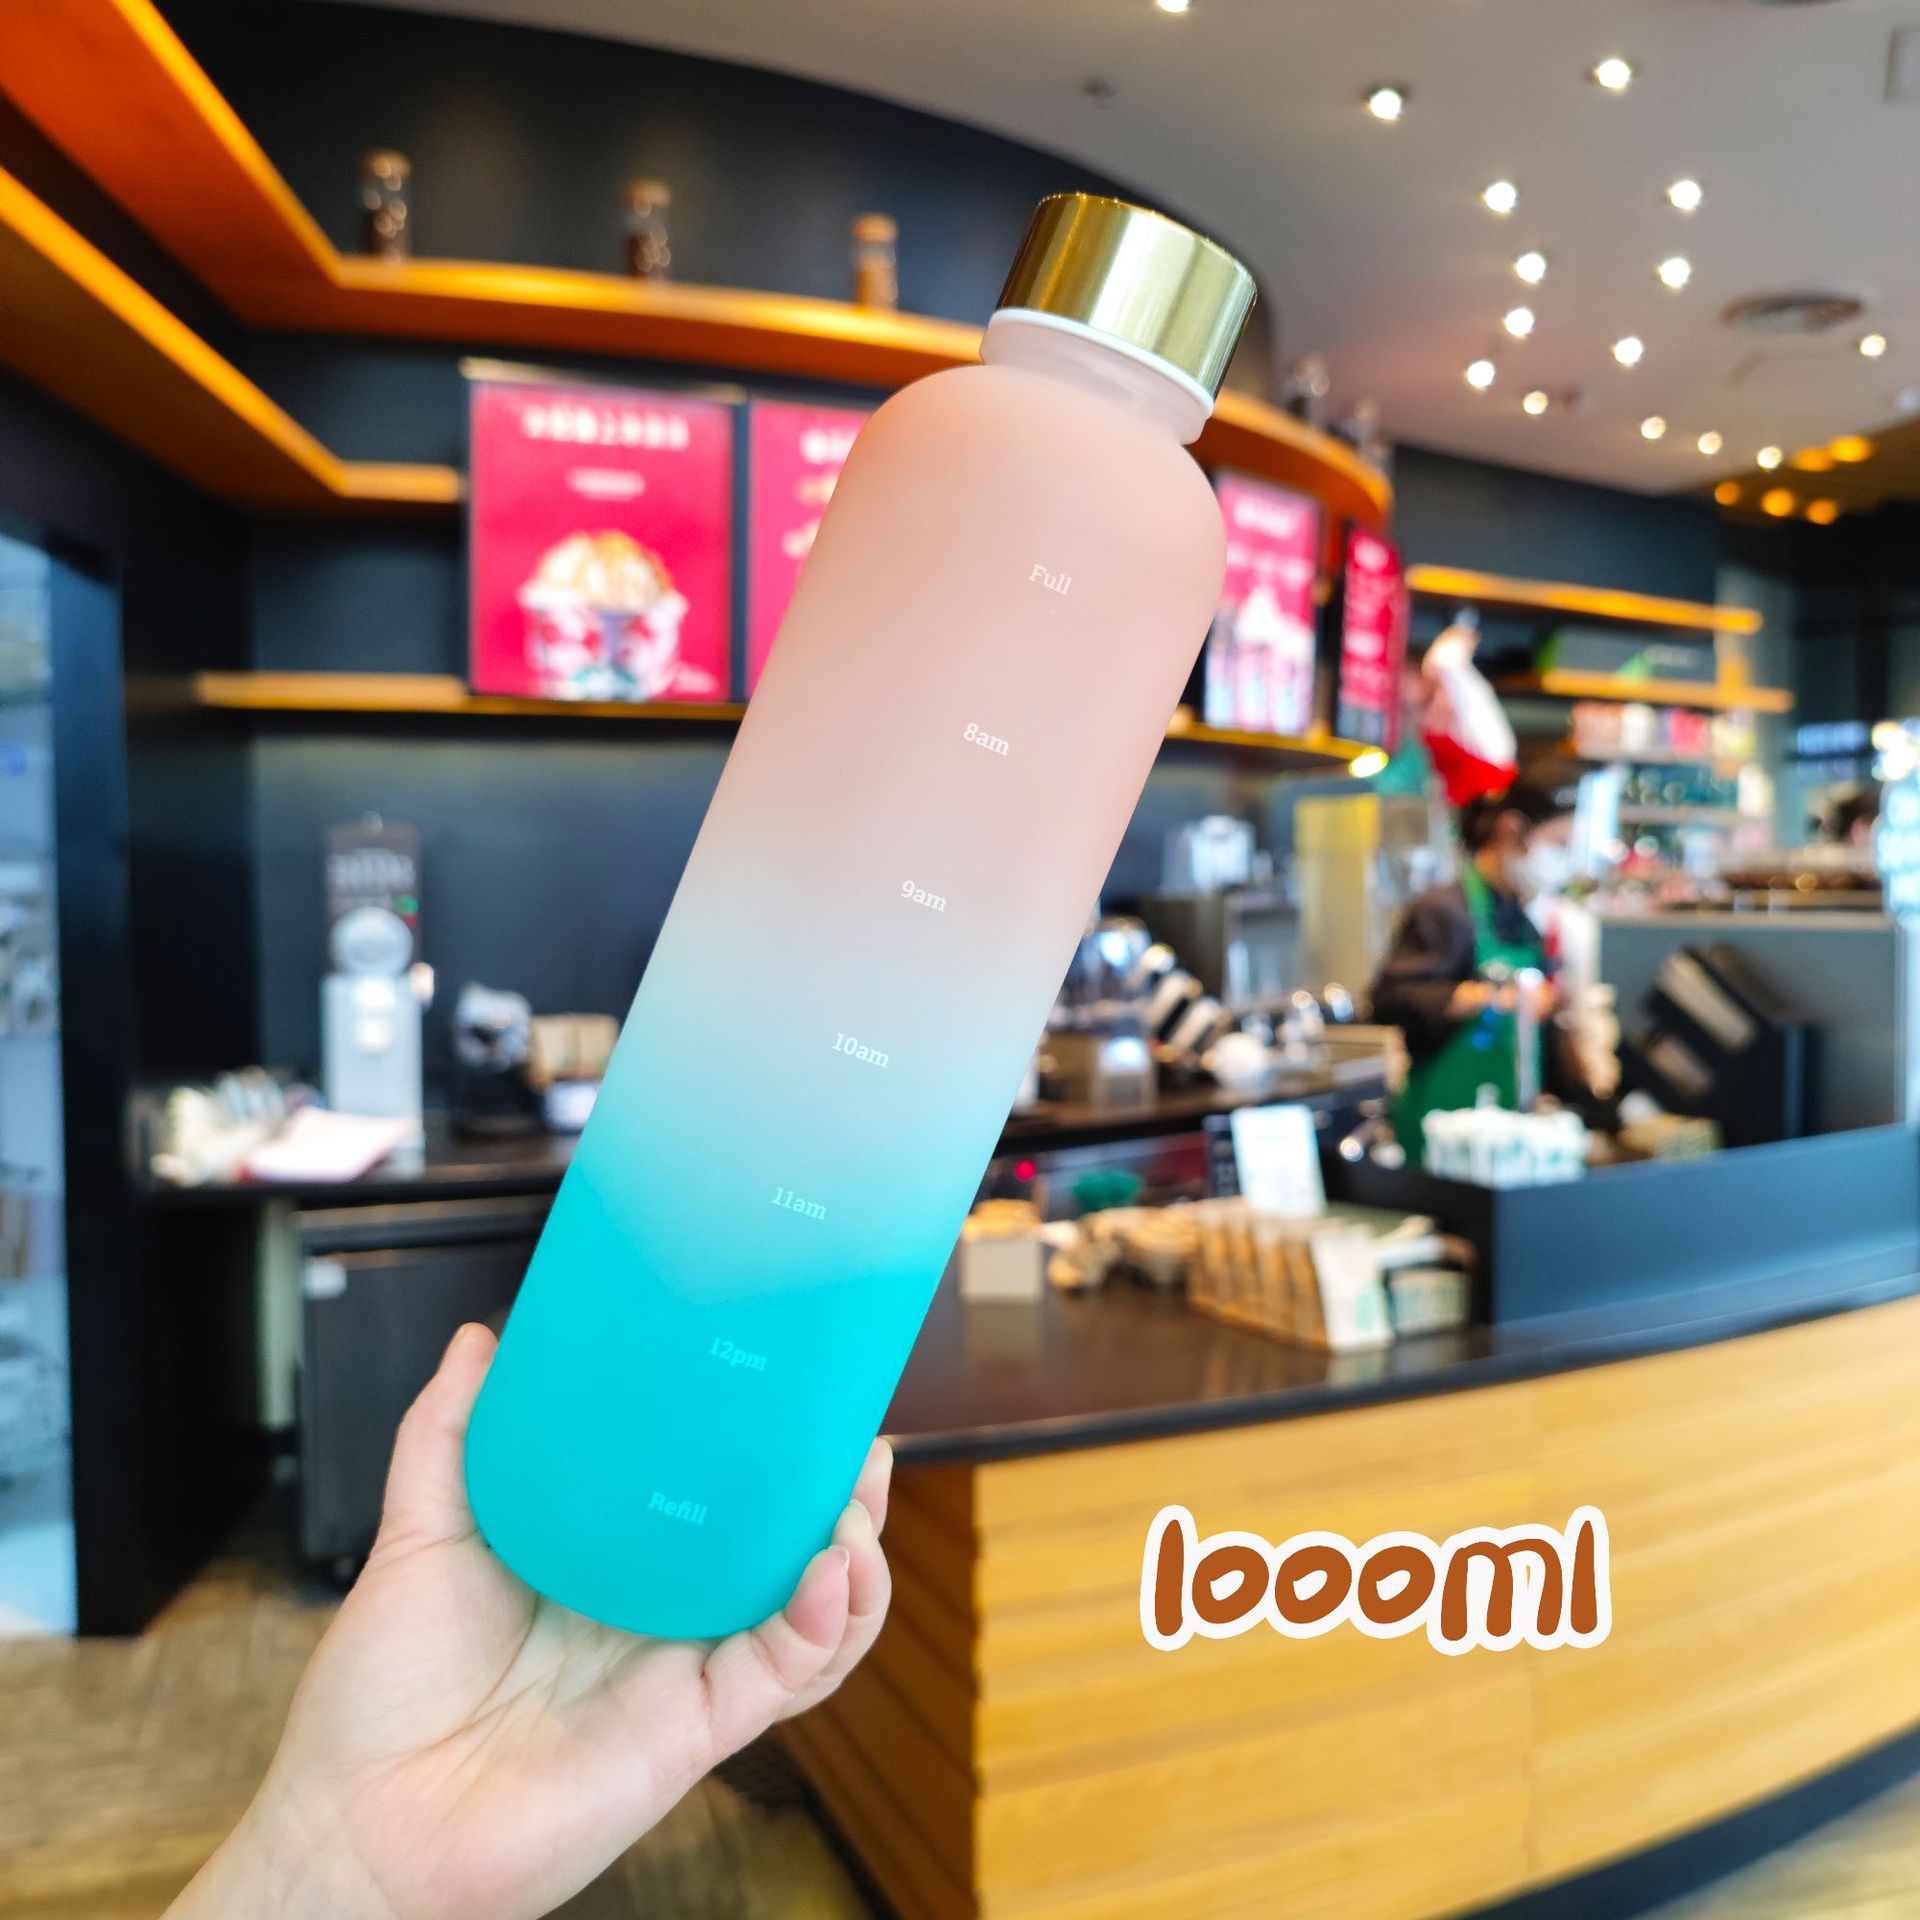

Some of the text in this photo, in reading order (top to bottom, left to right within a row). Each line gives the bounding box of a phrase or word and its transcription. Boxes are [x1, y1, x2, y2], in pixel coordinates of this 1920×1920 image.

[1029, 563, 1072, 596] Full
[963, 722, 1009, 757] 8am
[900, 879, 947, 913] 9am
[831, 1032, 890, 1069] 10am
[771, 1186, 827, 1221] 11am
[708, 1337, 767, 1372] 12pm
[647, 1490, 708, 1526] Refill
